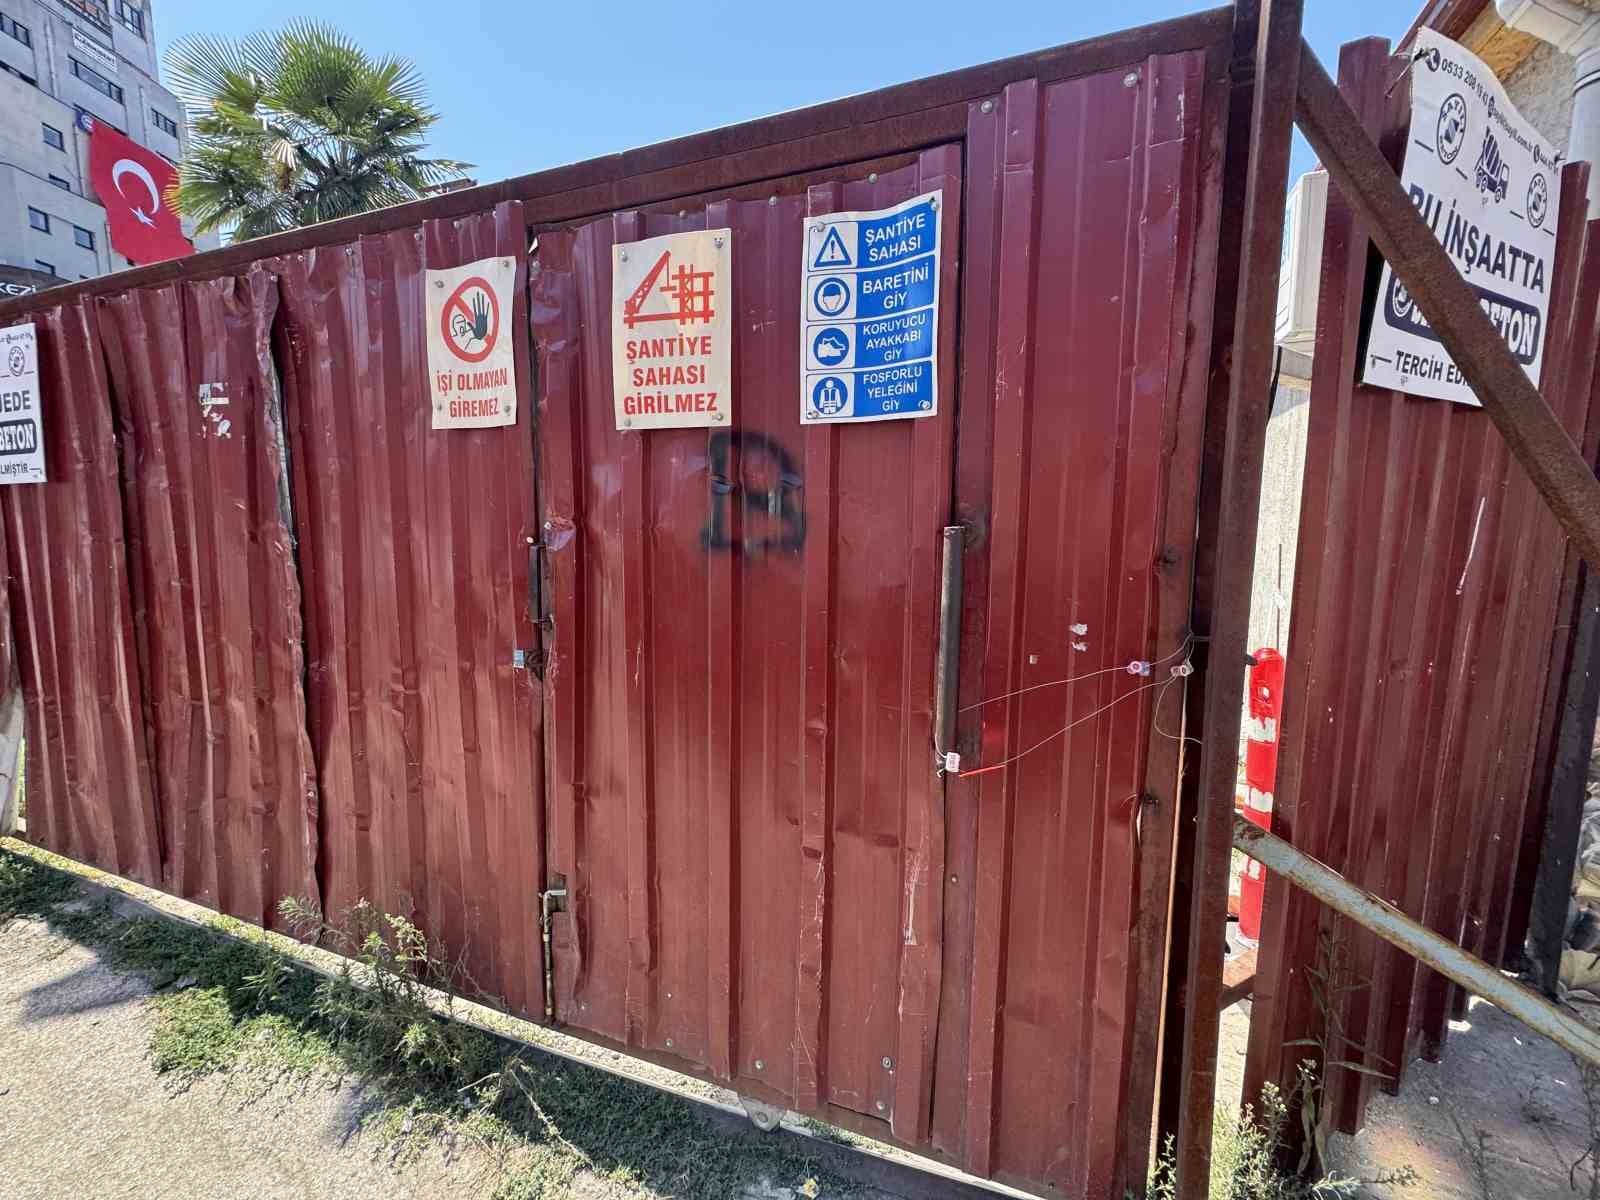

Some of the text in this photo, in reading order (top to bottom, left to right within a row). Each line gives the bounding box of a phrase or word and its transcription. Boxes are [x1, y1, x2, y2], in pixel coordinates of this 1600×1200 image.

[1441, 58, 1464, 79] 0533
[865, 212, 926, 248] ŞANTİYE
[868, 234, 921, 262] SAHASI
[1441, 198, 1544, 294] İNŞAATTA
[863, 262, 929, 294] BARETİNİ
[883, 291, 907, 309] GİY
[863, 313, 926, 335] KORUYUCU
[626, 333, 712, 364] ŞANTİYE
[865, 329, 921, 351] AYAKKABI
[883, 346, 902, 361] GİY
[633, 364, 705, 387] SAHASI
[863, 366, 922, 384] FOSFORLU
[1396, 350, 1443, 381] TERCİH
[436, 367, 507, 396] İŞİ OLMAYAN
[0, 390, 32, 413] EDE
[449, 395, 499, 417] GİREMEZ
[623, 391, 718, 415] GİRİLMEZ
[882, 397, 900, 411] GİY
